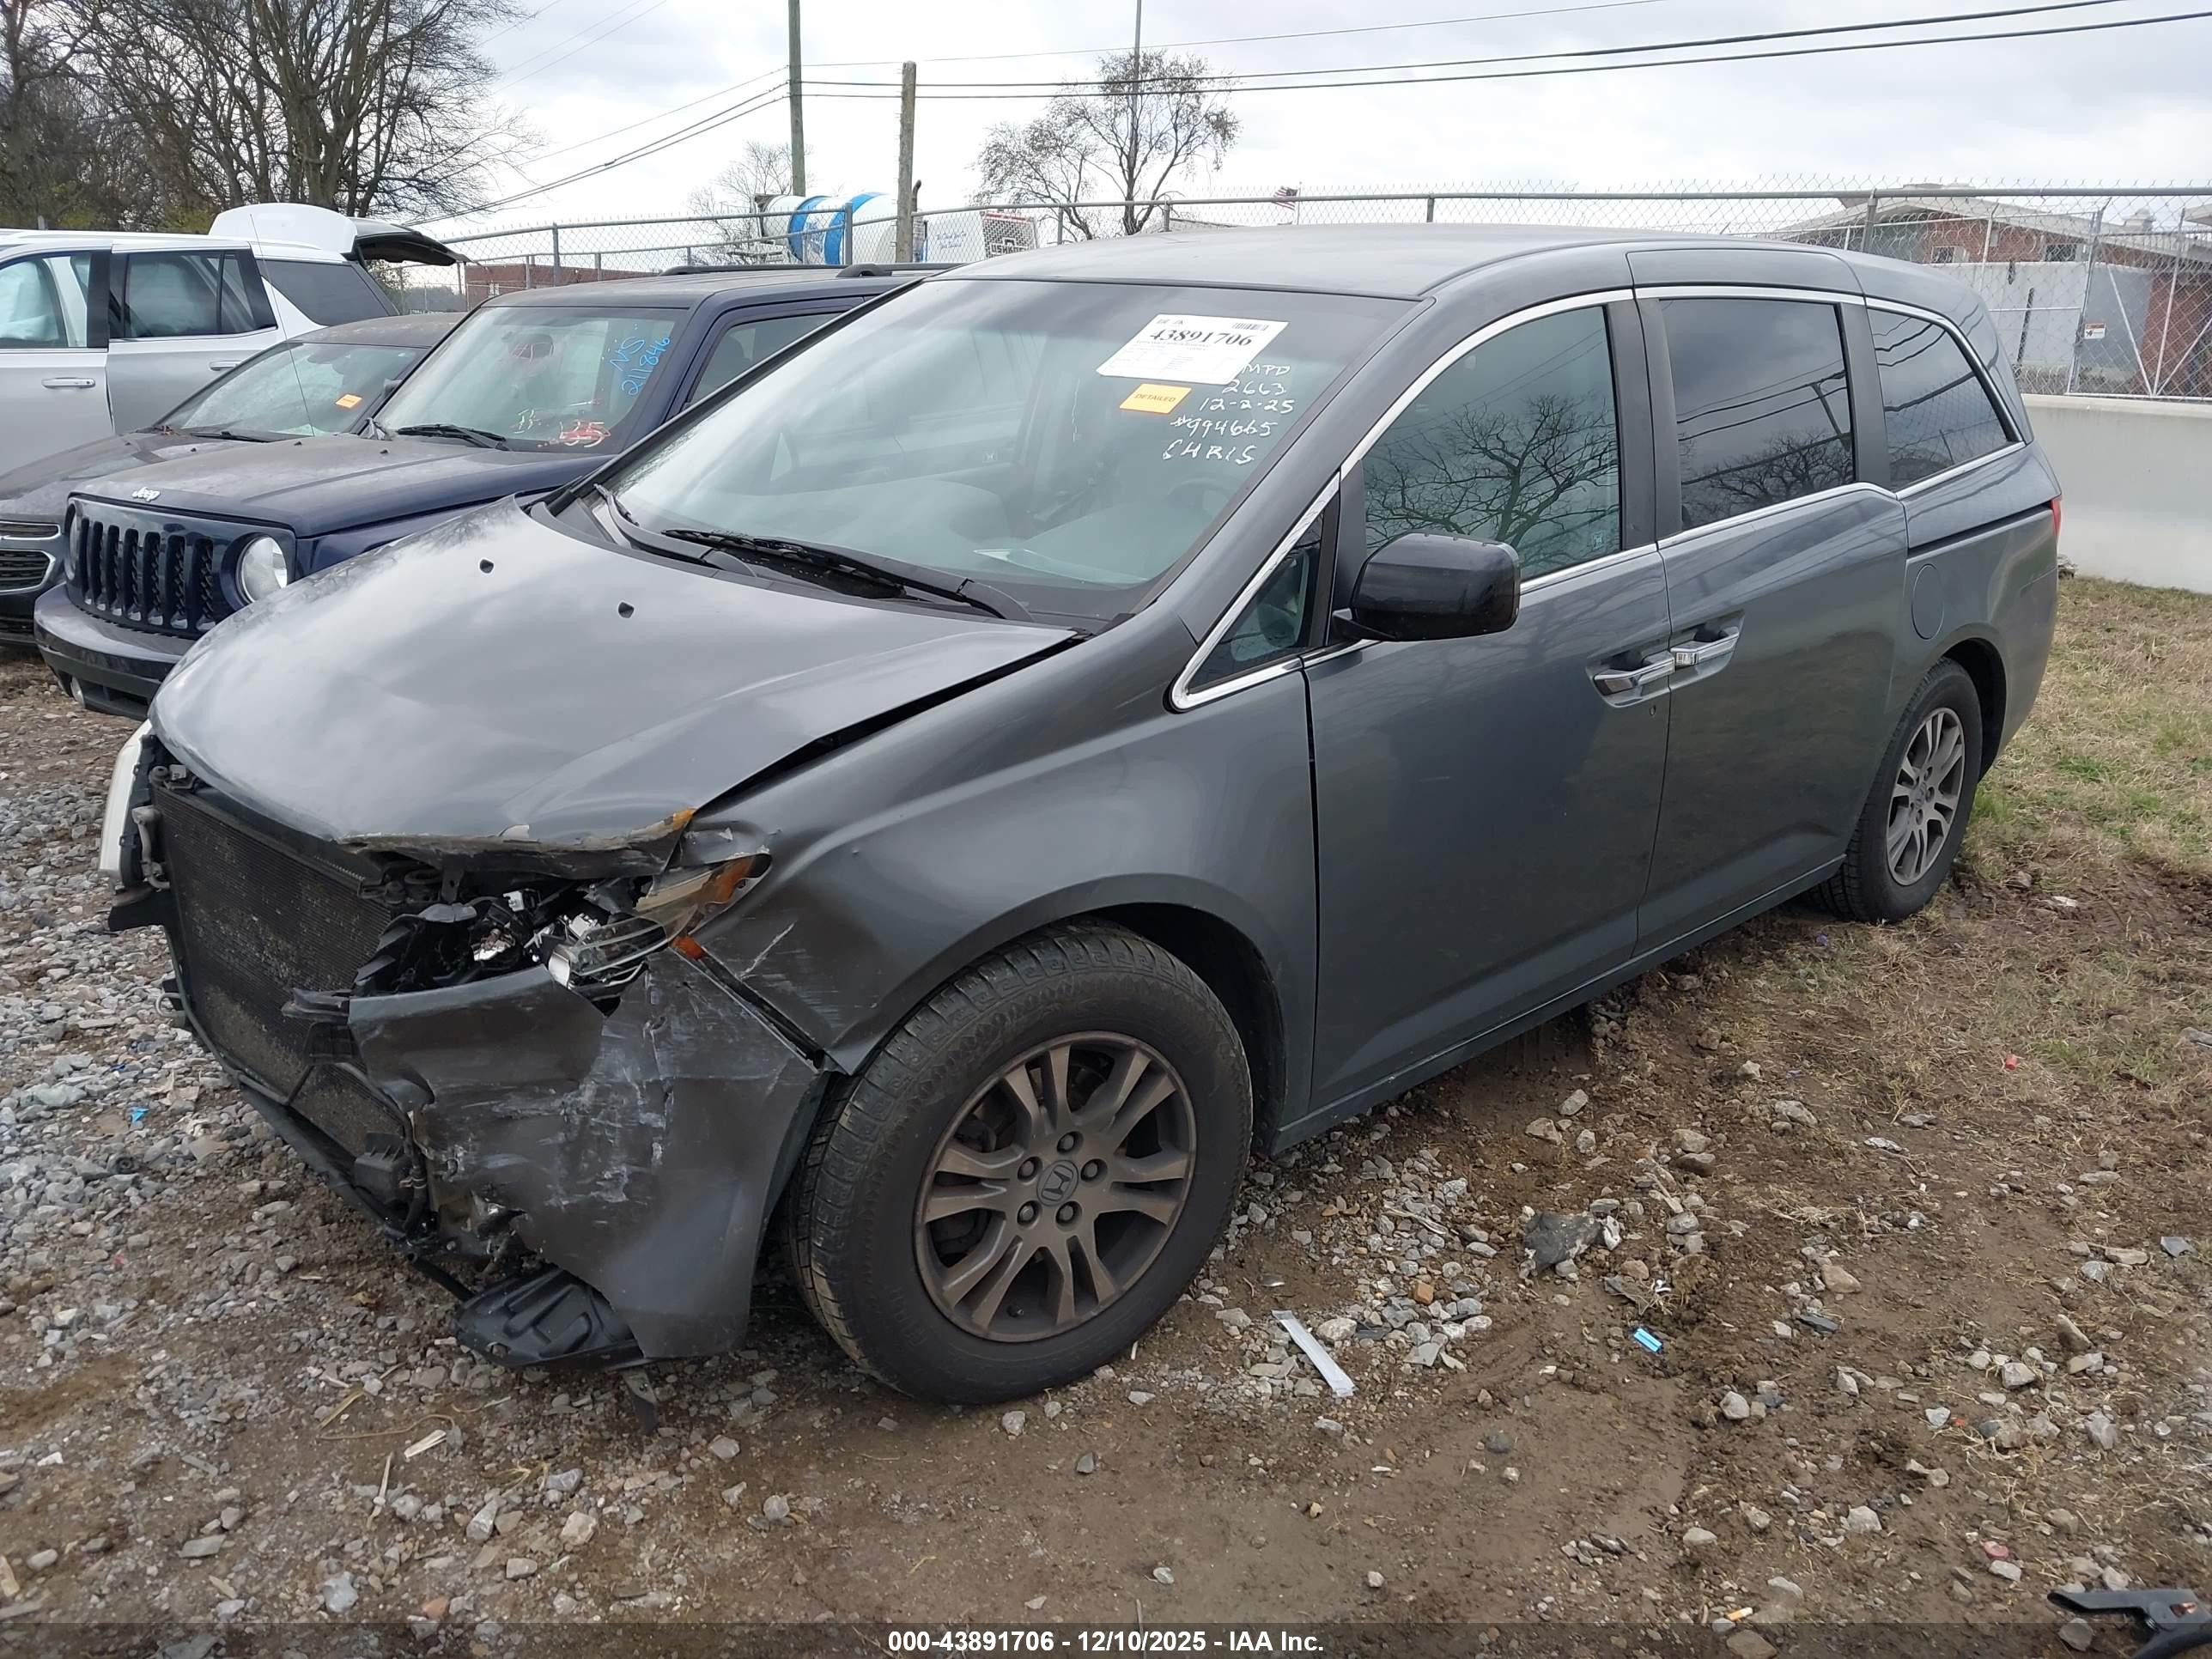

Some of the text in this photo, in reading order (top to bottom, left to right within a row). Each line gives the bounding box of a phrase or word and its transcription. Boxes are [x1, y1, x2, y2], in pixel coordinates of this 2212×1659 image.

[1150, 328, 1255, 347] 43891706
[620, 336, 671, 396] 211846
[1222, 378, 1287, 395] 2663
[1133, 392, 1177, 403] DETAILED
[1162, 439, 1258, 465] CHRIS
[131, 486, 161, 502] Jeep
